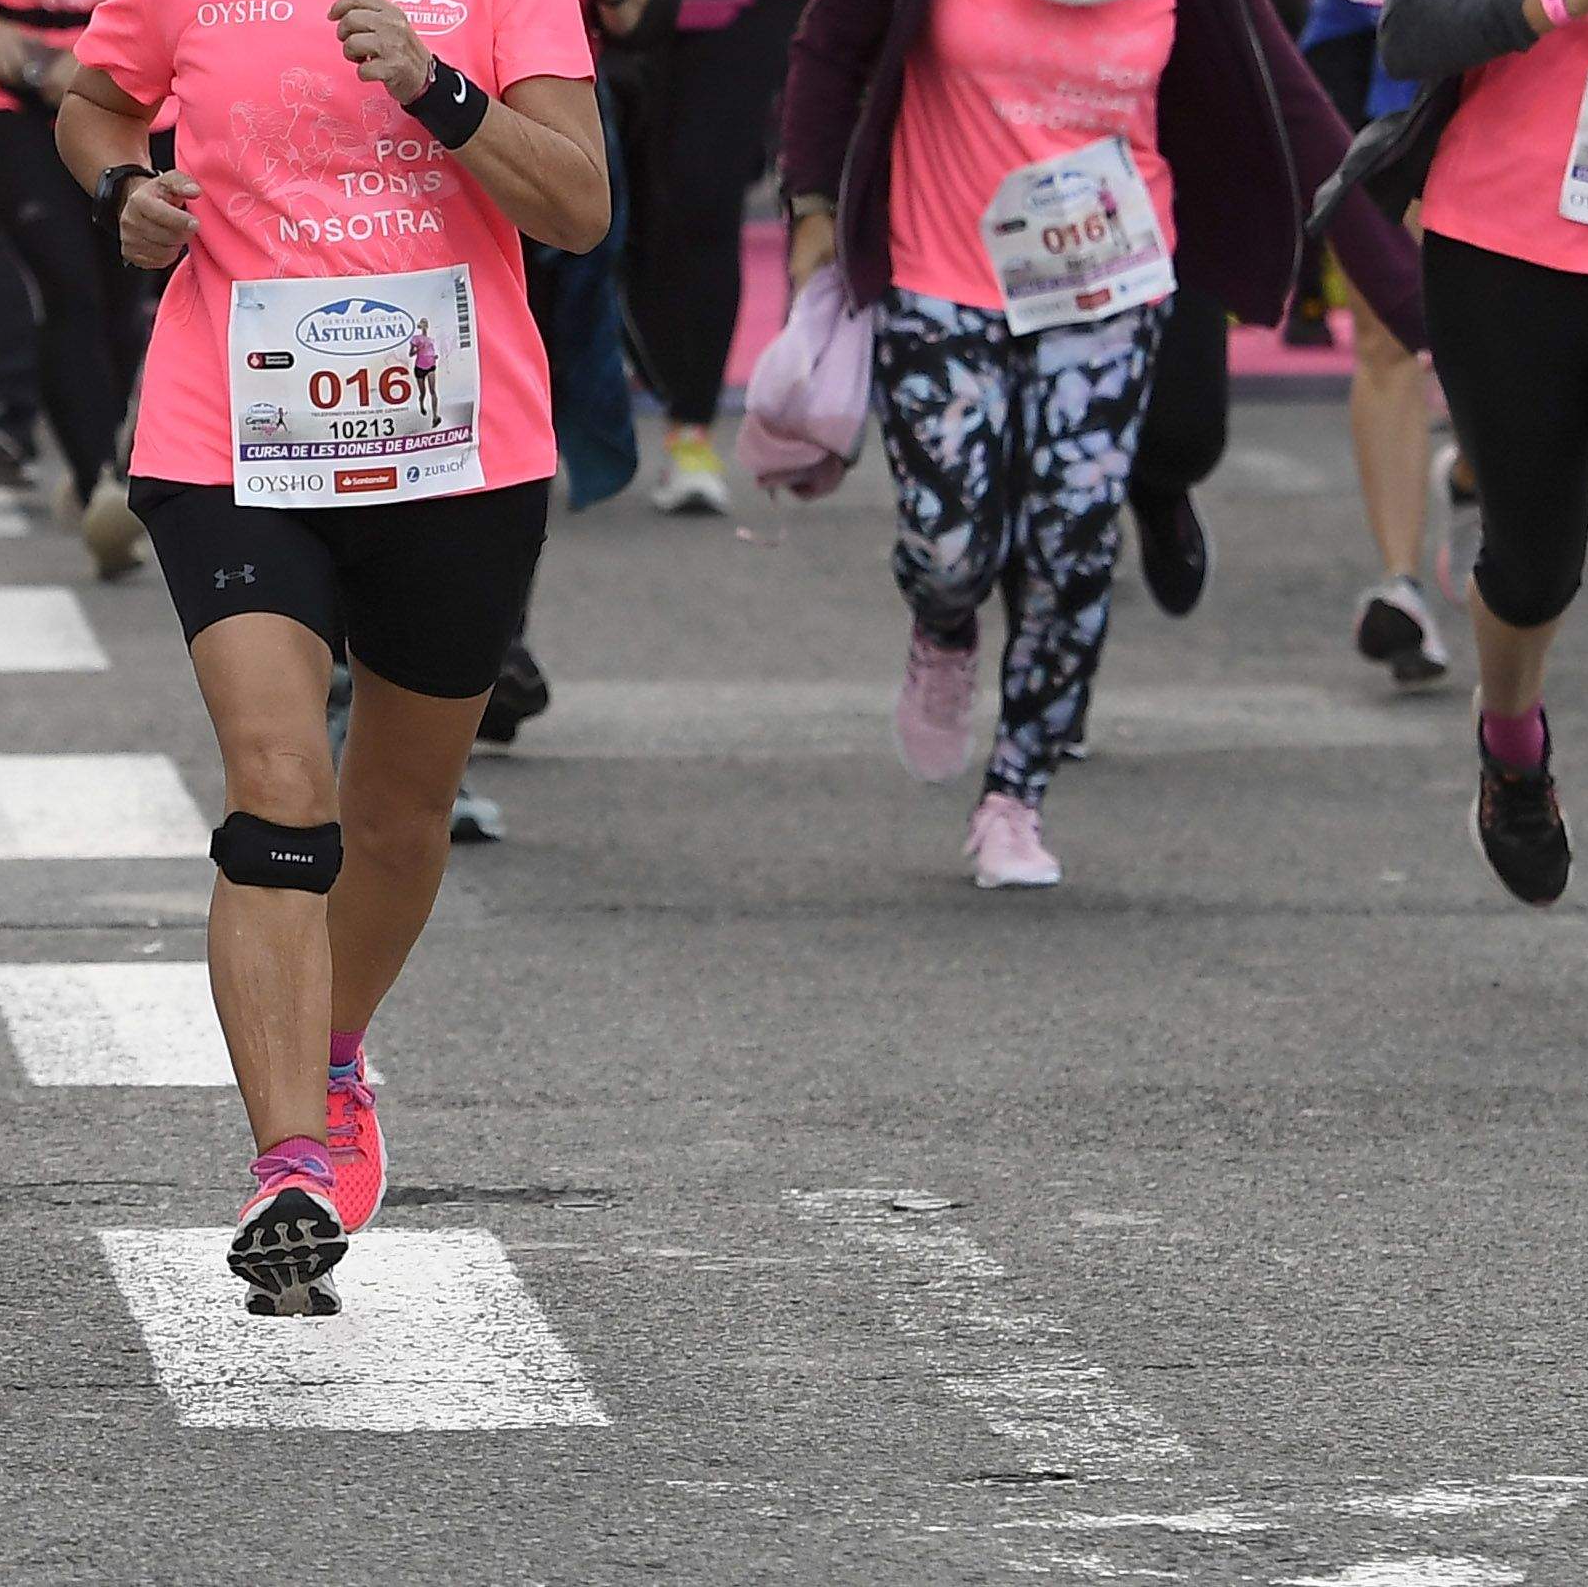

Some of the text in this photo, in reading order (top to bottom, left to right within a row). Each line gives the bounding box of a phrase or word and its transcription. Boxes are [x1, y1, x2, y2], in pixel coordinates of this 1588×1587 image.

[197, 0, 293, 27] OYSHO
[405, 11, 462, 25] TURIANA
[375, 139, 444, 163] POR
[1042, 213, 1106, 254] 016
[306, 320, 407, 343] ASTURIANA
[308, 365, 413, 410] 016
[329, 417, 395, 439] 10213
[246, 428, 470, 458] CURSA DE LES DONES DE BARCELONA
[424, 461, 465, 477] ZURICH
[247, 474, 324, 494] OYSHO
